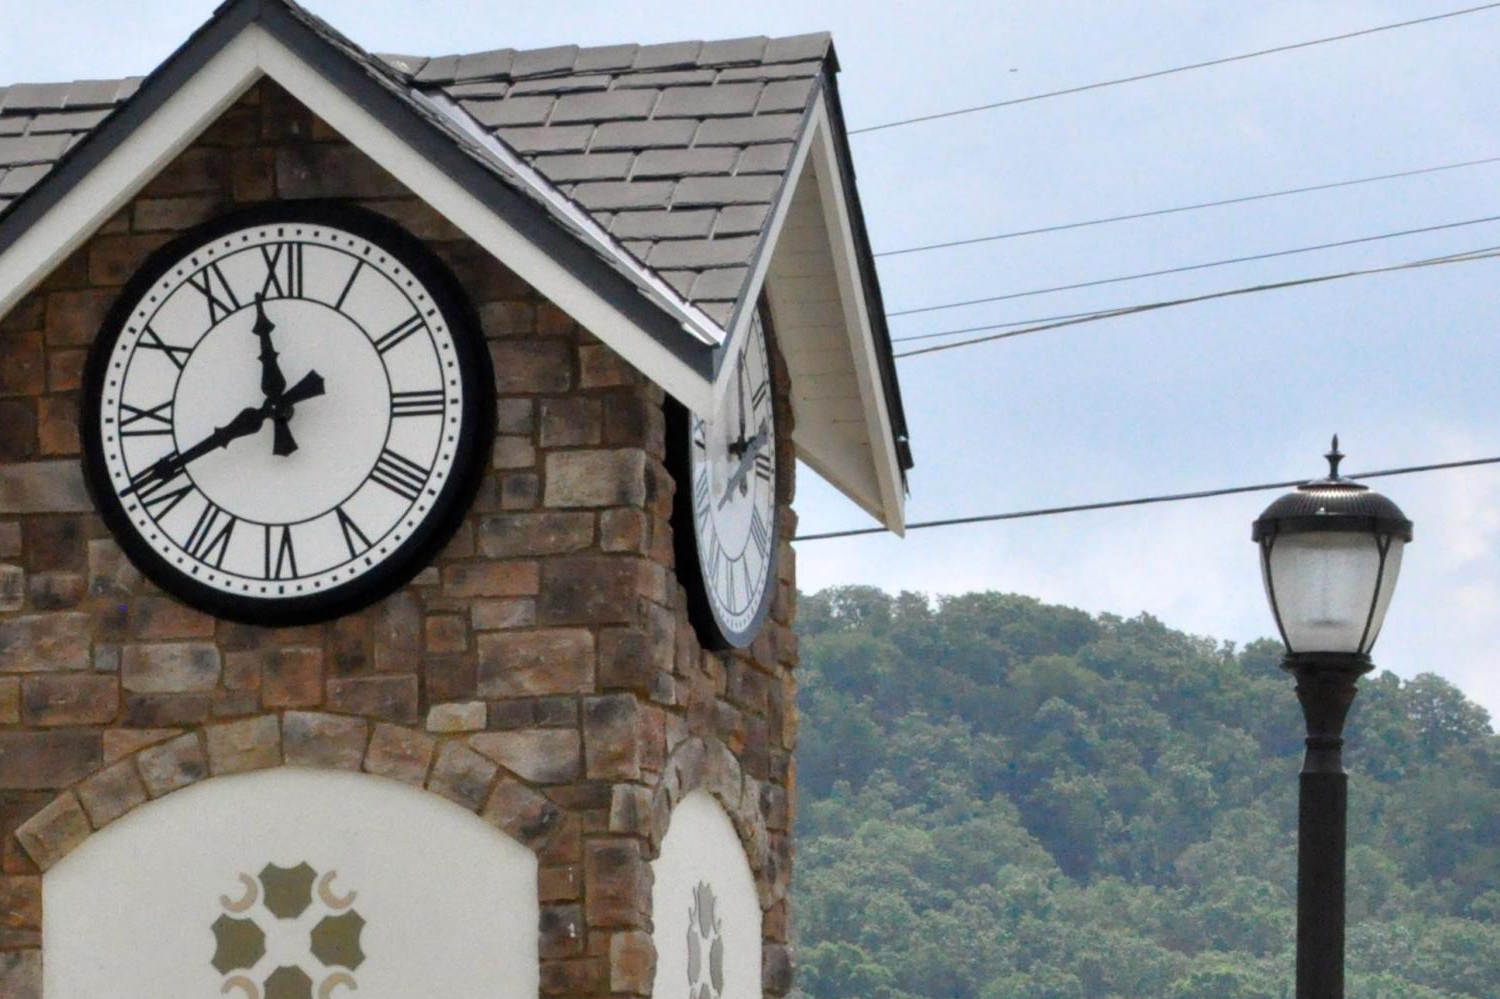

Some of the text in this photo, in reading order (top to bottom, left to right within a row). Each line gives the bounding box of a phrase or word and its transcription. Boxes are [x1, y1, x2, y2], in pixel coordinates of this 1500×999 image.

[186, 261, 242, 326] XI
[259, 242, 303, 299] XII
[334, 258, 366, 312] I
[135, 325, 194, 371] X
[373, 313, 427, 354] II
[119, 400, 174, 437] IX
[392, 389, 446, 417] III
[129, 450, 197, 523] VII
[368, 447, 433, 504] IIII
[183, 500, 236, 570] VII
[263, 524, 298, 580] VI
[336, 505, 375, 559] V
